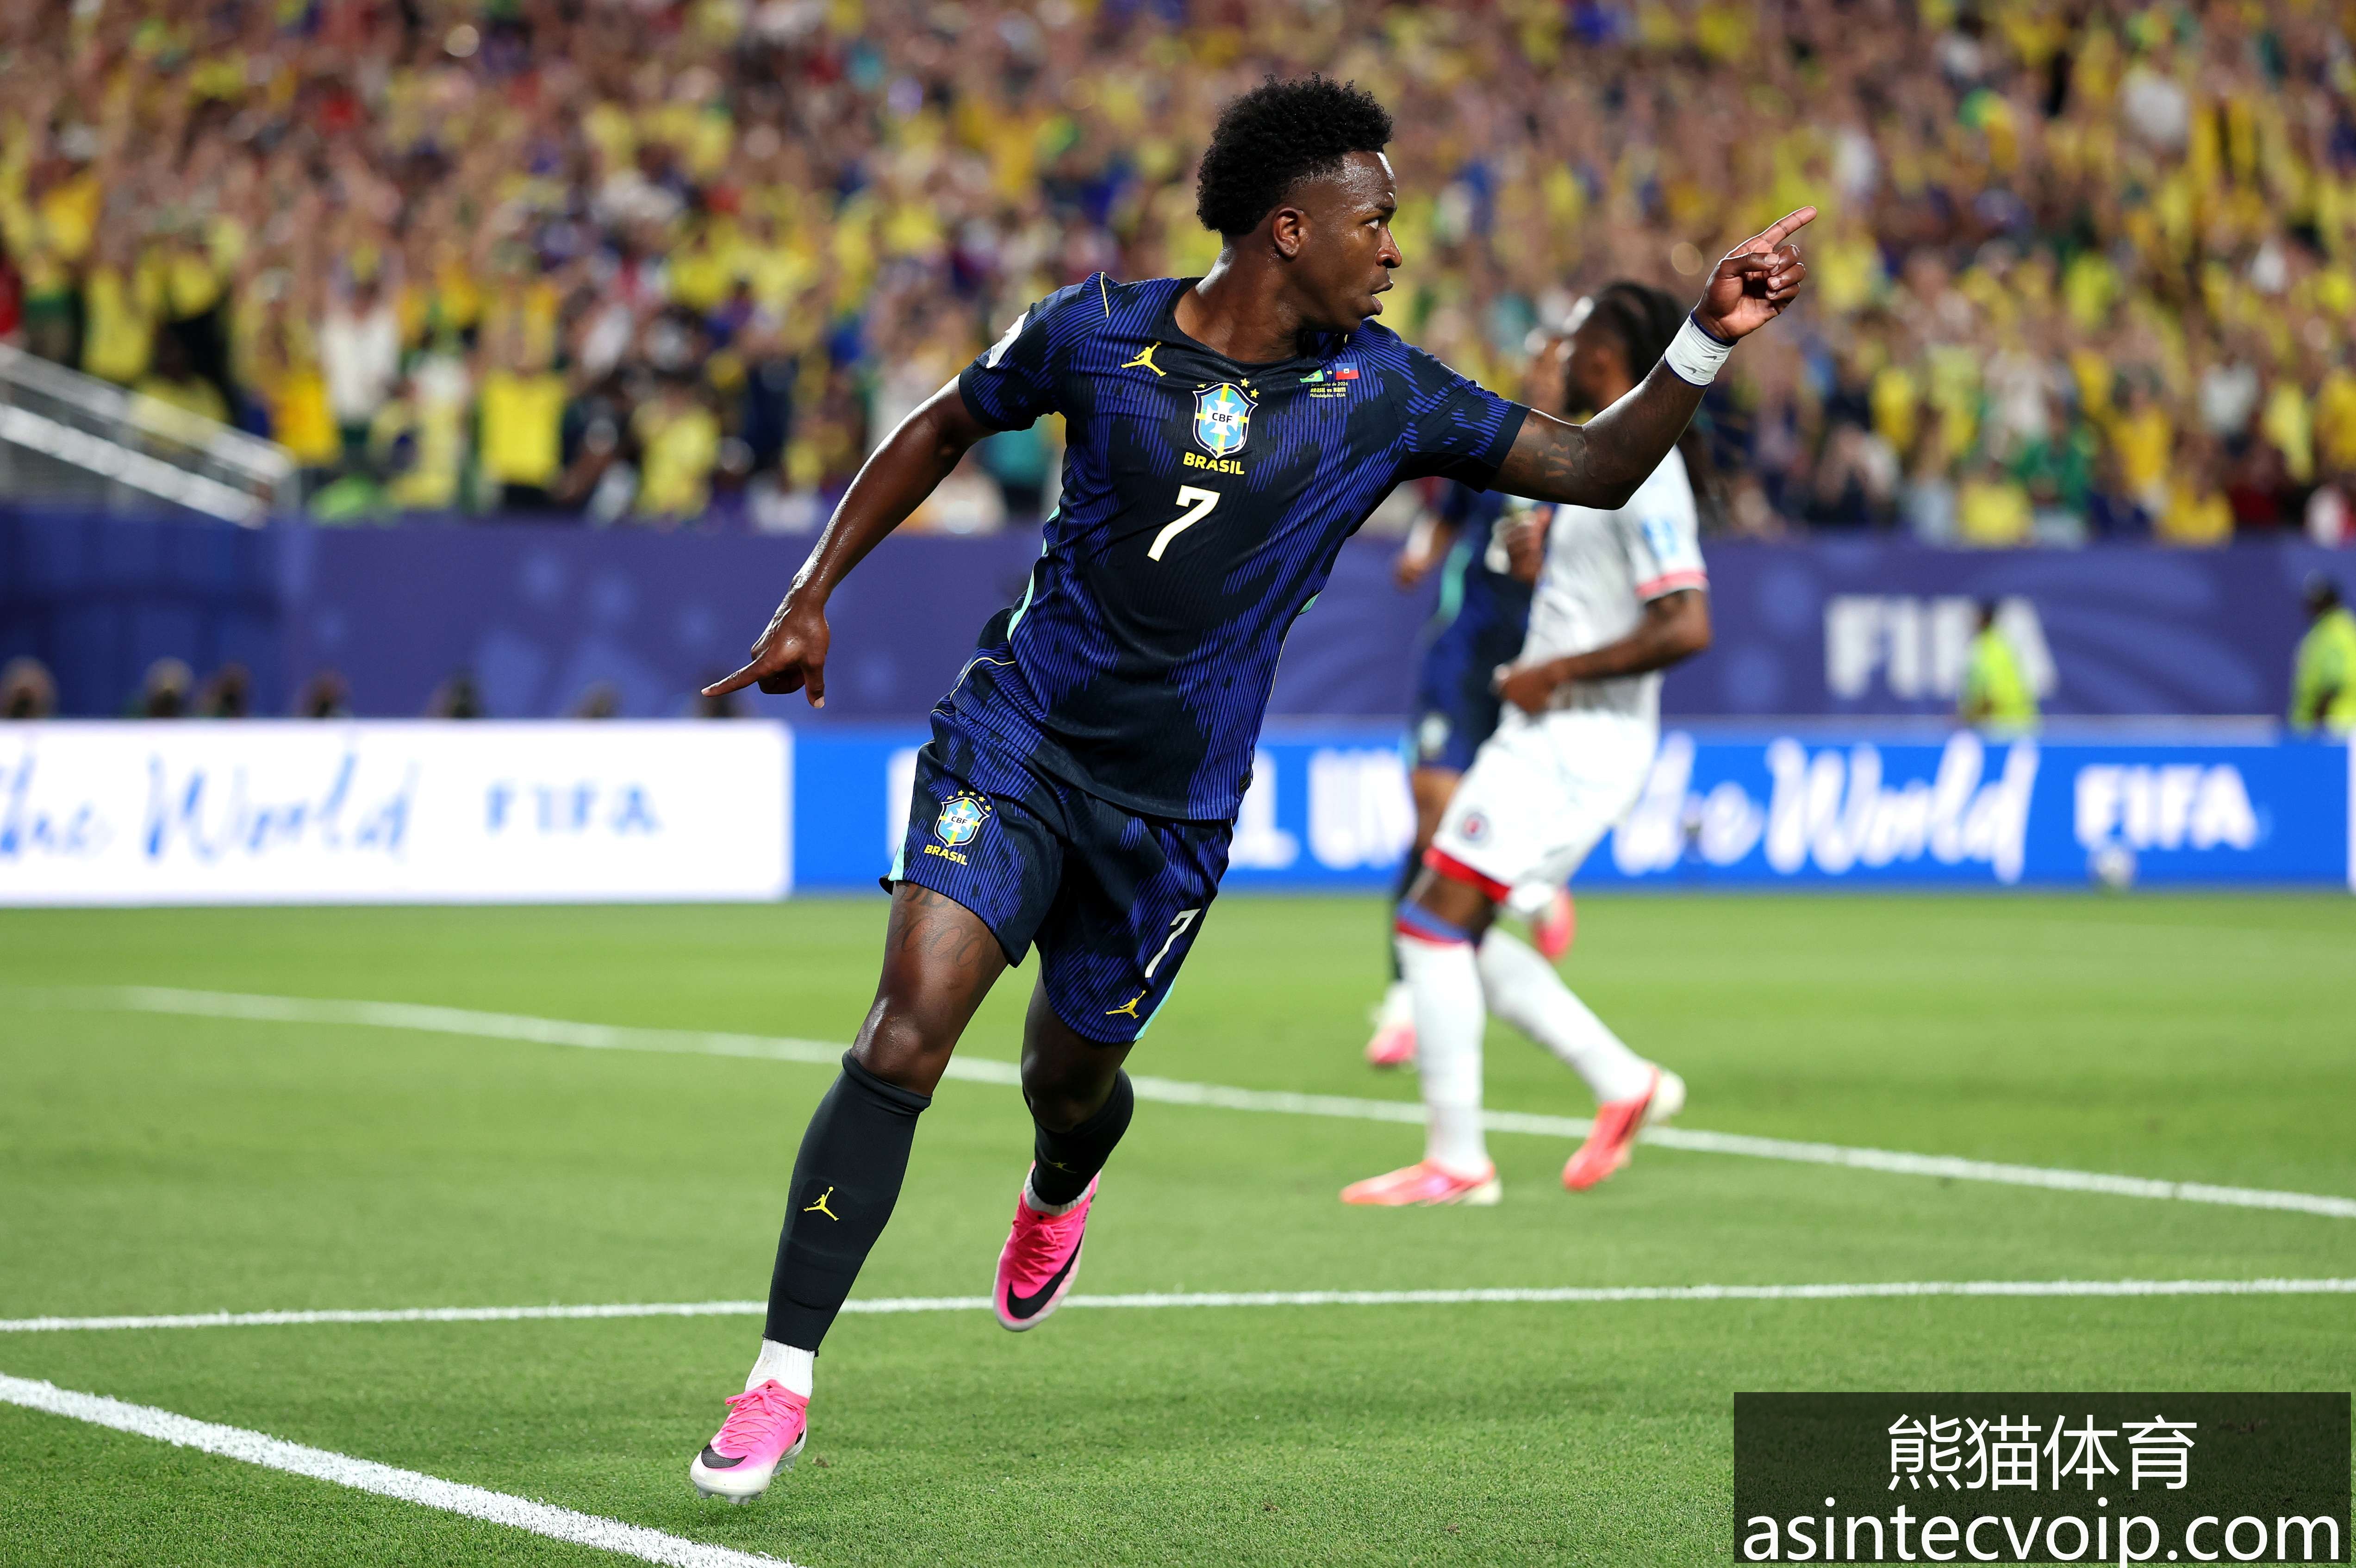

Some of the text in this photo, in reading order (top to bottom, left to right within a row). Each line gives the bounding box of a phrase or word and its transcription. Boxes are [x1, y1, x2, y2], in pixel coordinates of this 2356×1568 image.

[1212, 412, 1233, 423] CBF
[1183, 451, 1245, 475] BRASIL
[1147, 485, 1221, 562] 7
[2074, 763, 2259, 852] FIFA
[951, 816, 968, 825] CBF
[924, 844, 968, 866] BRASIL
[1145, 908, 1201, 978] 7
